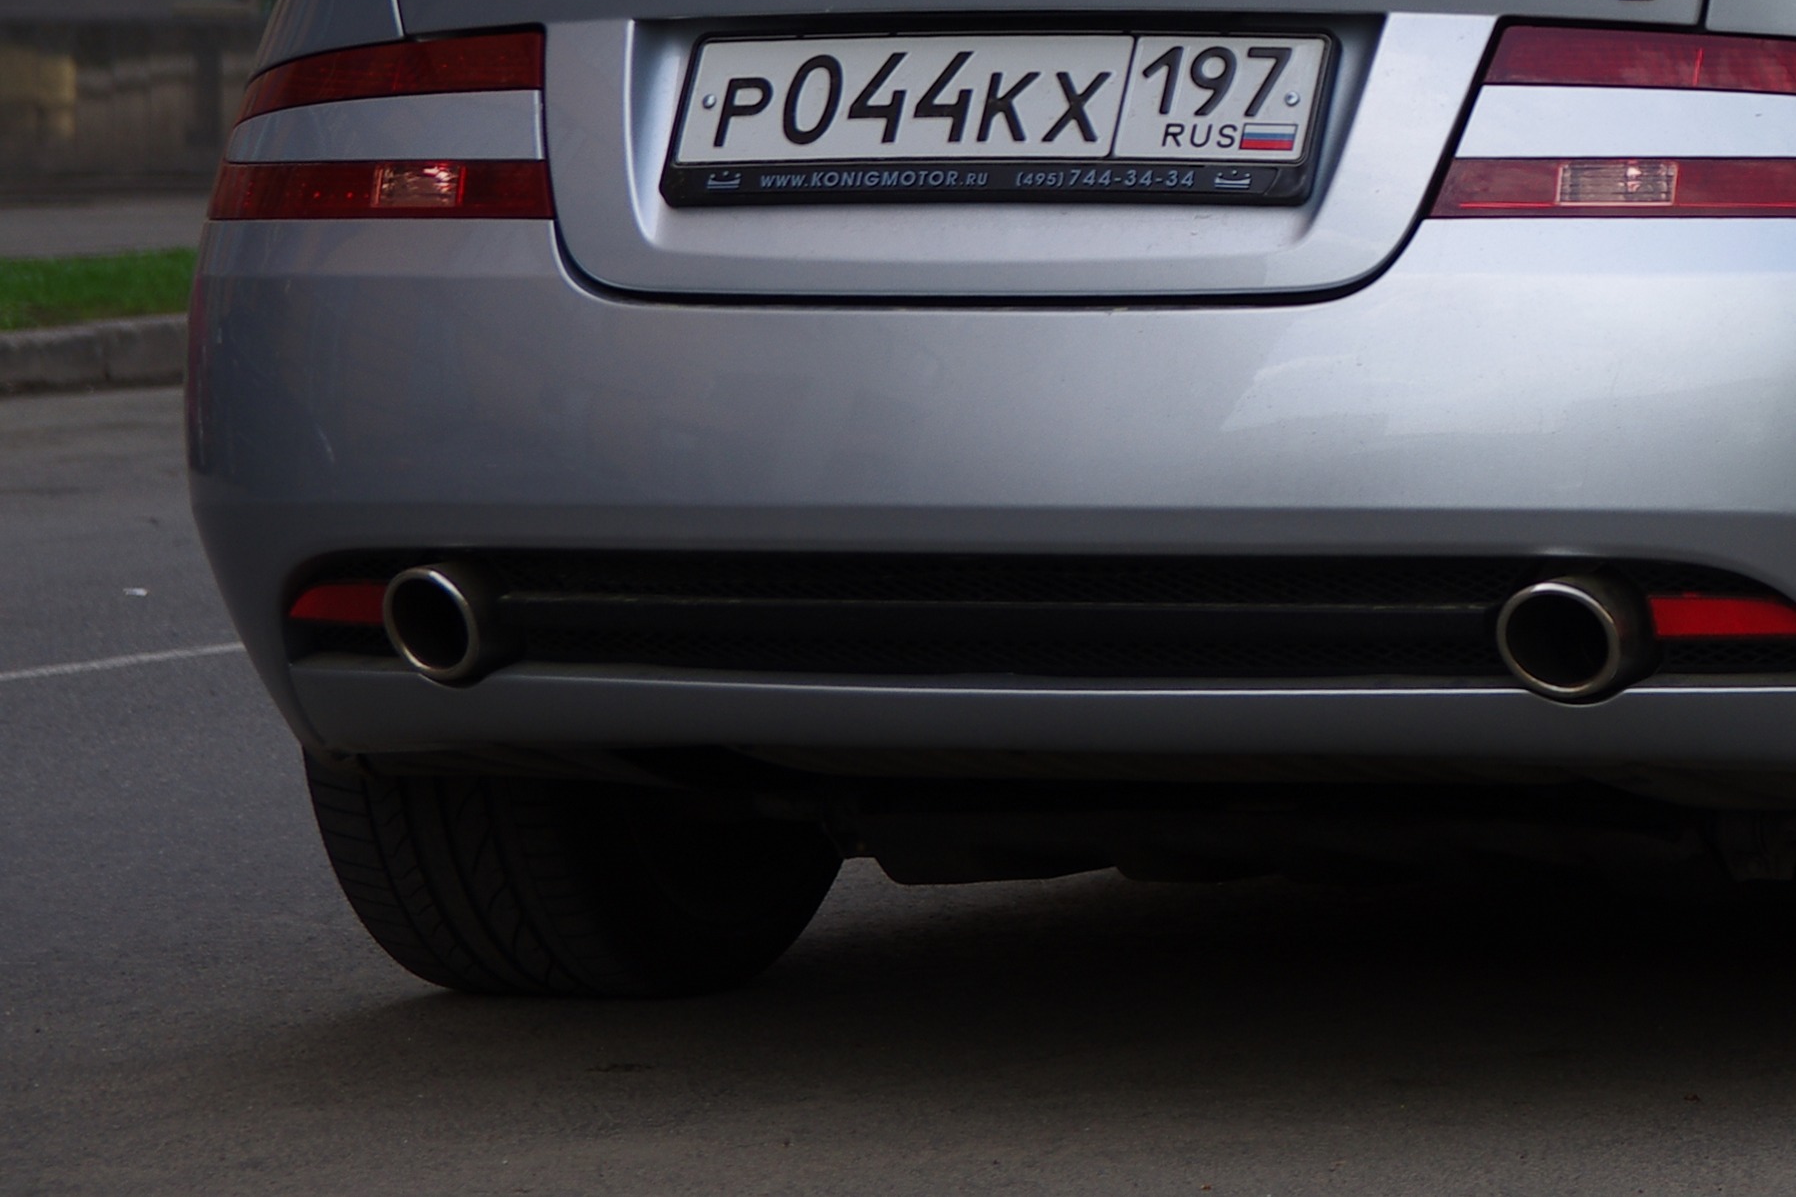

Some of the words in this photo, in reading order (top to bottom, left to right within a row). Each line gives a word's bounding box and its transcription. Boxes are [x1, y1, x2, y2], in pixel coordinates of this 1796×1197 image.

[1142, 45, 1293, 118] 197
[1161, 123, 1238, 149] RUS
[1015, 170, 1064, 188] (495)
[1068, 168, 1197, 189] 744-34-34
